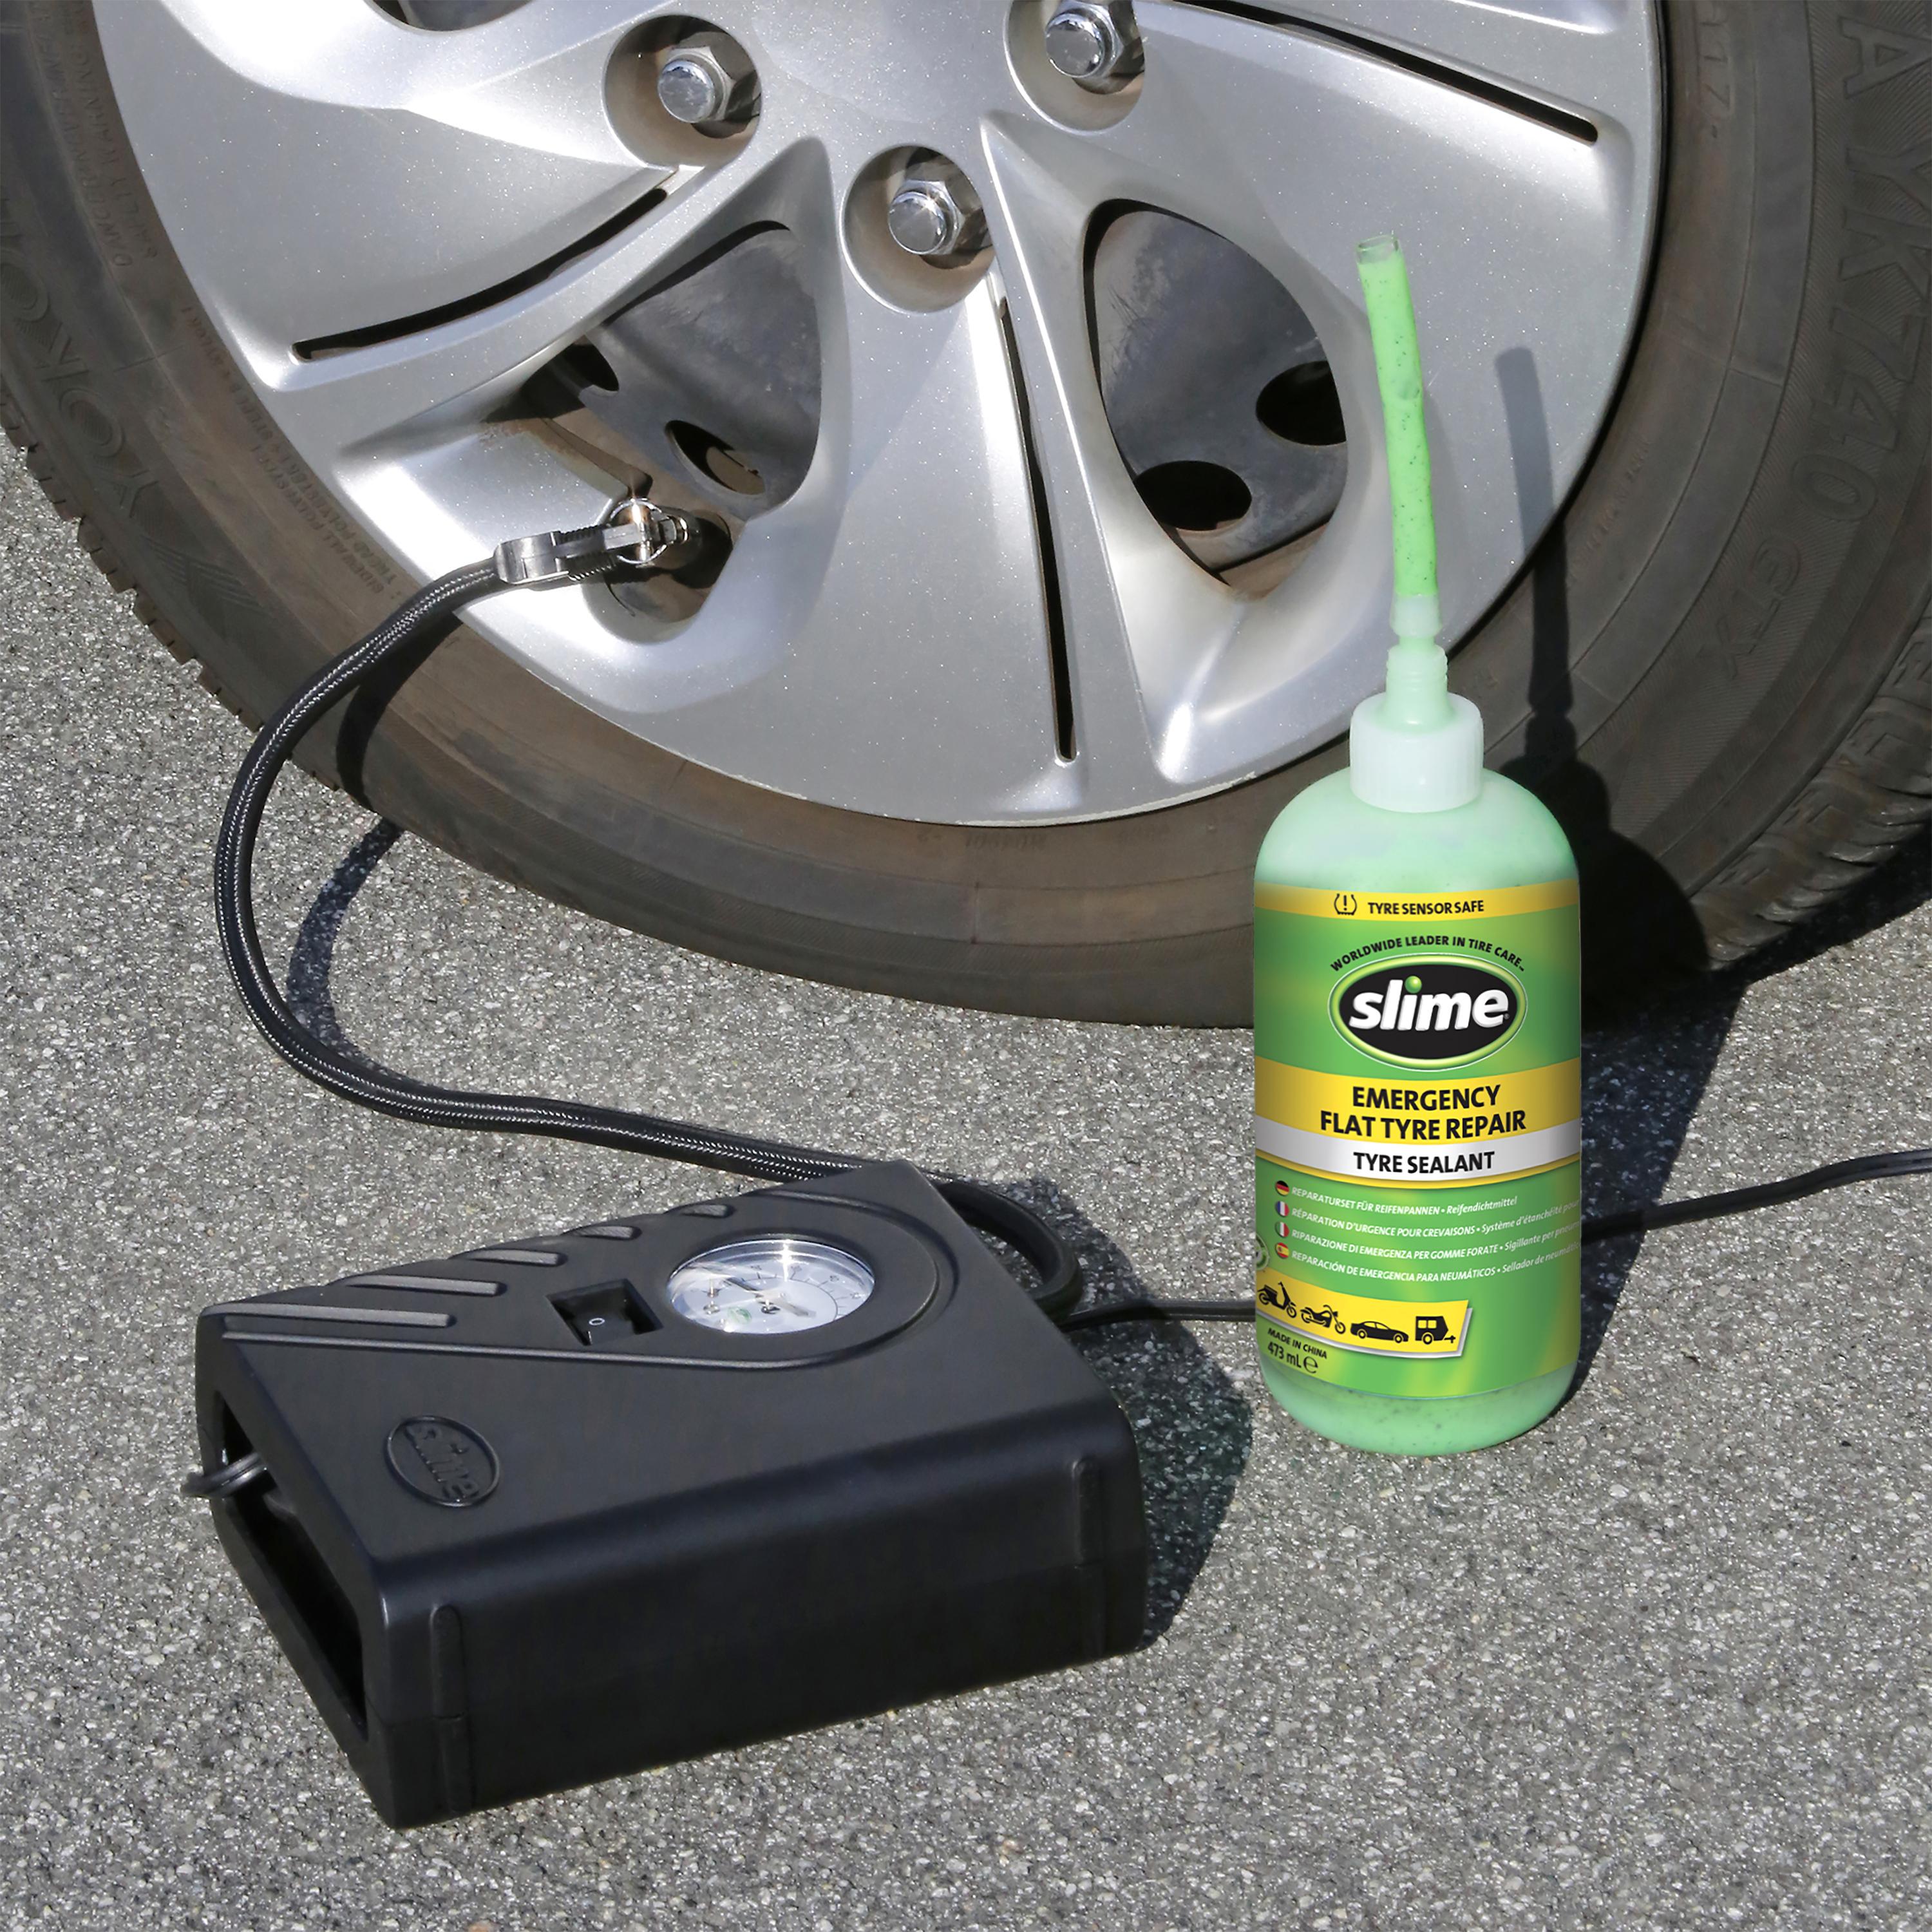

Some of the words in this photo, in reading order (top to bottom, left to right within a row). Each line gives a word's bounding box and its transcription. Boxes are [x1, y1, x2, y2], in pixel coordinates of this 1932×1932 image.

[1368, 902, 1399, 914] TYRE
[1402, 902, 1452, 915] SENSOR
[1455, 900, 1484, 913] SAFE
[1331, 937, 1403, 971] WORLDWIDE
[1405, 936, 1449, 946] LEADER
[1452, 936, 1465, 947] IN
[1469, 939, 1492, 953] TIRE
[1352, 1084, 1501, 1110] EMERGENCY
[1321, 1110, 1376, 1137] FLAT
[1381, 1118, 1440, 1140] TYRE
[1446, 1110, 1526, 1139] REPAIR
[1354, 1151, 1403, 1173] TYRE
[1407, 1151, 1495, 1173] SEALANT
[1292, 1187, 1356, 1208] REPARATURSET
[1356, 1200, 1373, 1212] FÜR
[1375, 1204, 1440, 1215] REIFENPANNEN
[1446, 1196, 1518, 1216] Reifendichtmittel
[1292, 1208, 1344, 1229] RÉPARATION
[1397, 1228, 1422, 1236] POUR
[1423, 1226, 1475, 1236] CREVAISONS
[1481, 1221, 1515, 1235] Système
[1563, 1200, 1580, 1214] pour
[1291, 1229, 1349, 1252] RIPARAZIONE
[1349, 1244, 1359, 1253] DI
[1359, 1245, 1412, 1259] EMERGENZA
[1414, 1251, 1429, 1259] PER
[1430, 1249, 1466, 1260] GOMME
[1466, 1244, 1499, 1256] FORATE
[1504, 1235, 1541, 1252] Sigillante
[1541, 1231, 1555, 1243] per
[1291, 1250, 1346, 1273] REPARACIÓN
[1347, 1265, 1359, 1276] DE
[1359, 1267, 1416, 1282] EMERGENCIA
[1416, 1273, 1439, 1282] PARA
[1440, 1267, 1495, 1281] NEUMÁTICOS
[1502, 1259, 1534, 1273] Sellador
[1535, 1253, 1545, 1265] de
[1267, 1328, 1291, 1345] MADE
[1292, 1340, 1302, 1350] IN
[1303, 1344, 1327, 1359] CHINA
[1267, 1341, 1284, 1359] 473
[1287, 1353, 1302, 1368] mL
